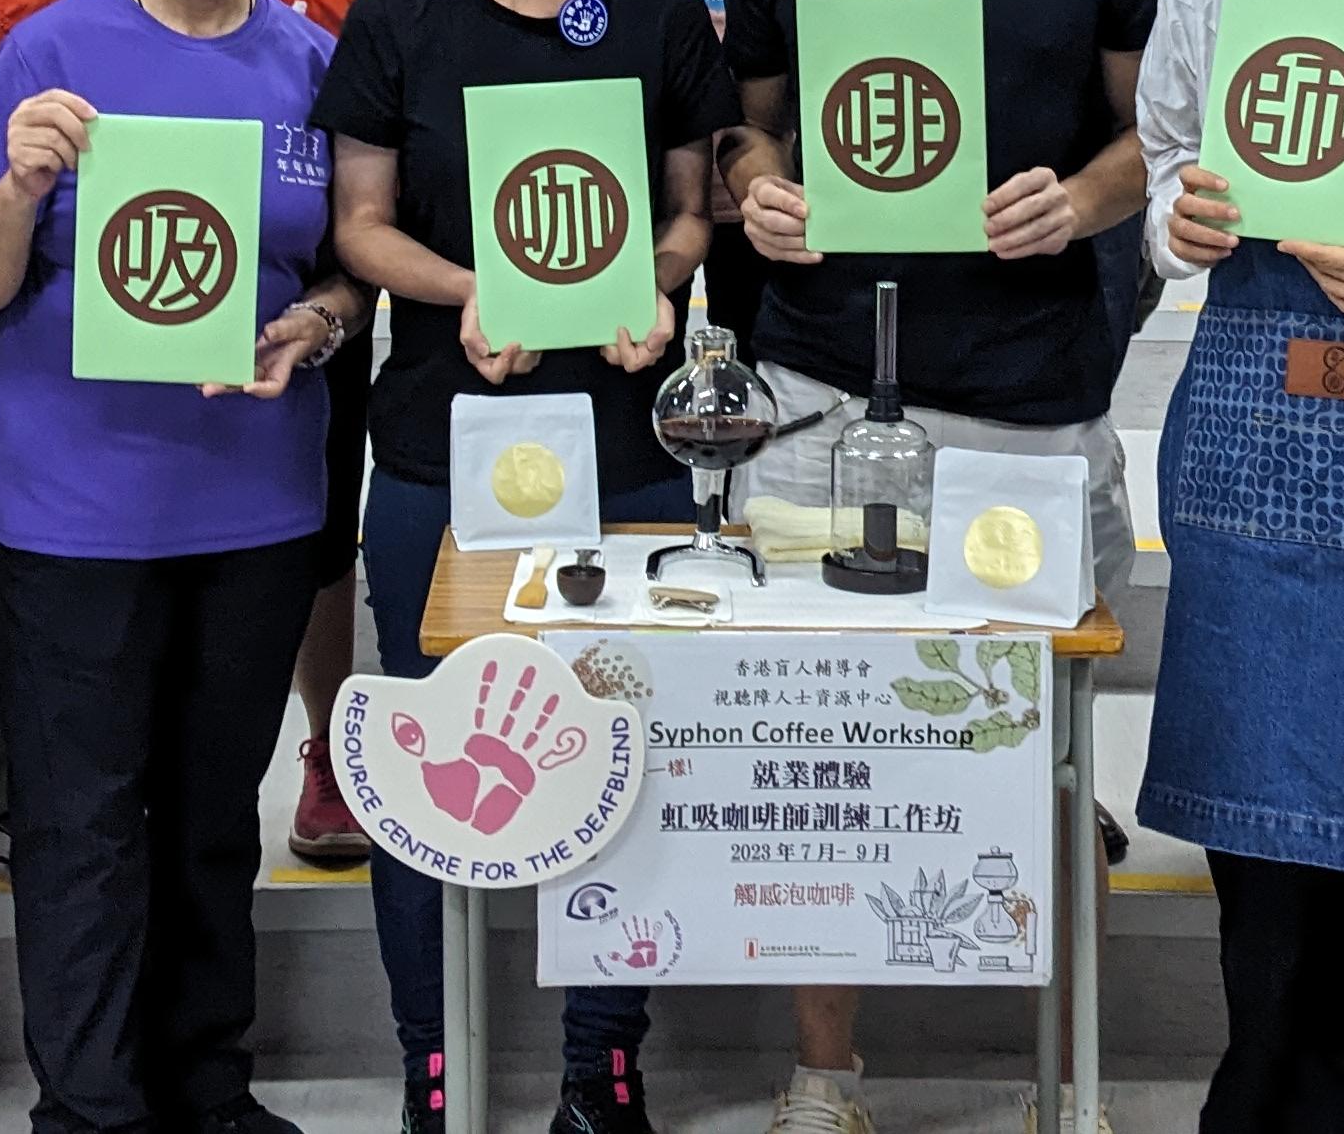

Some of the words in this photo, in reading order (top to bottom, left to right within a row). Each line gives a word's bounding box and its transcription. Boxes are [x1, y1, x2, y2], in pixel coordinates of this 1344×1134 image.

[834, 71, 946, 176] 啡
[506, 166, 618, 268] 咖
[116, 204, 219, 310] 吸
[735, 658, 873, 677] 香港盲人輔導會
[713, 687, 893, 708] 視聽障人士資源中心
[649, 720, 744, 747] Syphon
[751, 720, 834, 744] Coffee
[842, 722, 974, 749] Workshop
[343, 689, 383, 814] RESOURCE
[378, 816, 463, 877] CENTRE
[469, 861, 519, 882] FOR
[523, 839, 574, 875] THE
[573, 716, 632, 845] DEAFBLIND
[752, 760, 872, 789] 就業體驗
[661, 803, 963, 833] 虹吸咖啡師訓練工作坊
[733, 882, 856, 907] 觸感泡咖啡
